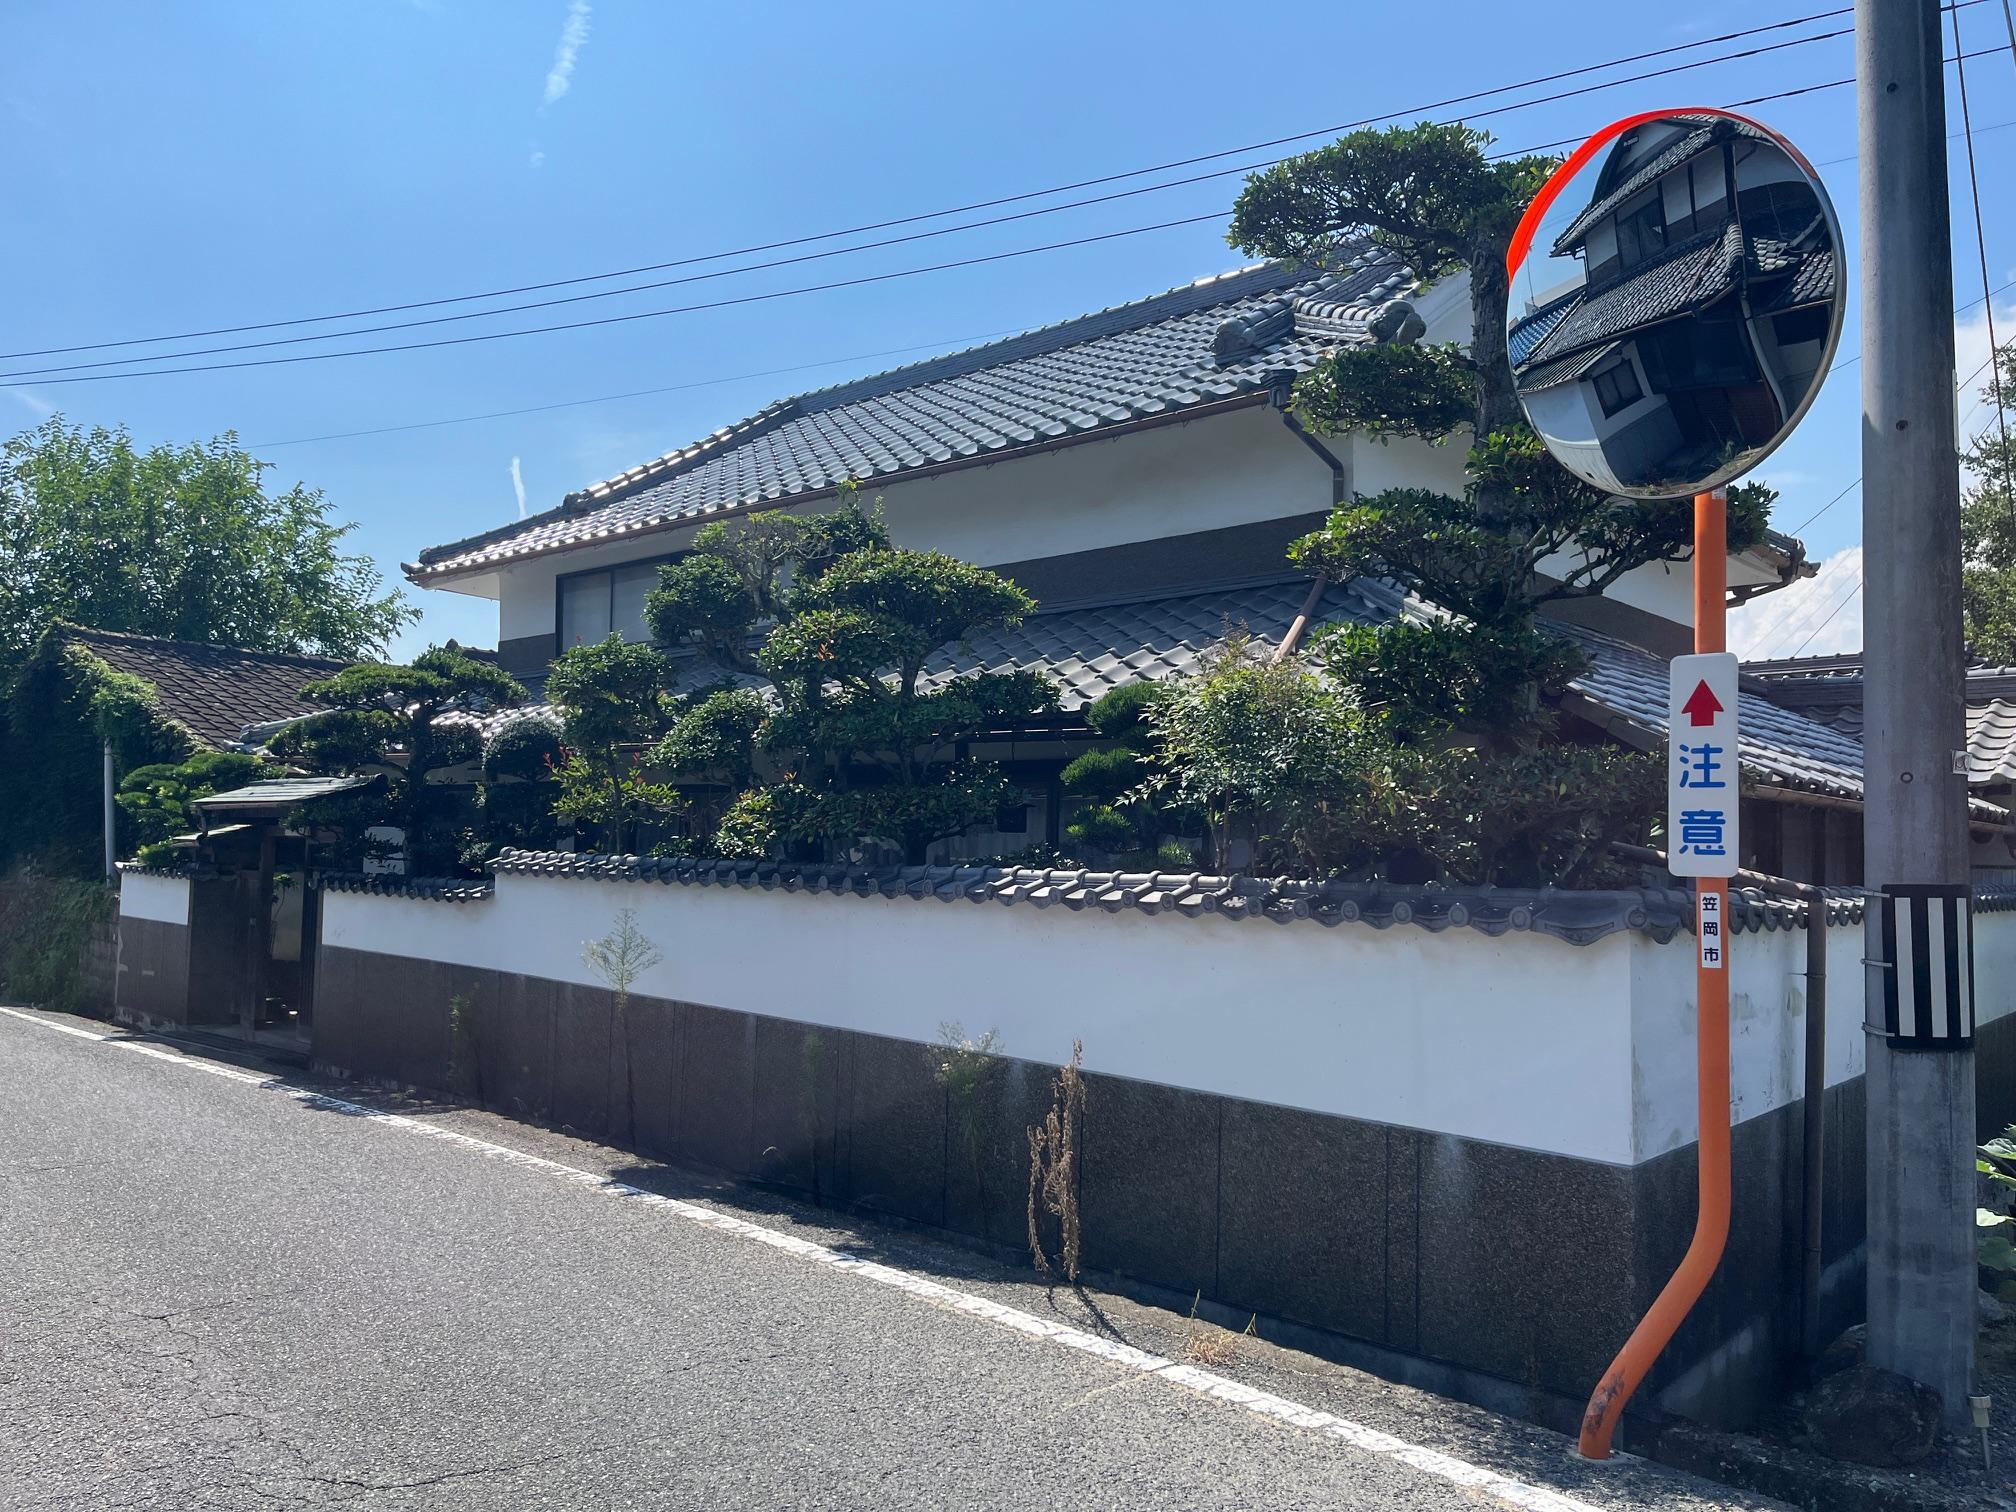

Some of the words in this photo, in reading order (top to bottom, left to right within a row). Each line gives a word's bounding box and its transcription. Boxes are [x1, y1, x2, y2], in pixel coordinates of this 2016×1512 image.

[1679, 743, 1727, 856] 注意
[1702, 896, 1719, 962] 笠岡市
